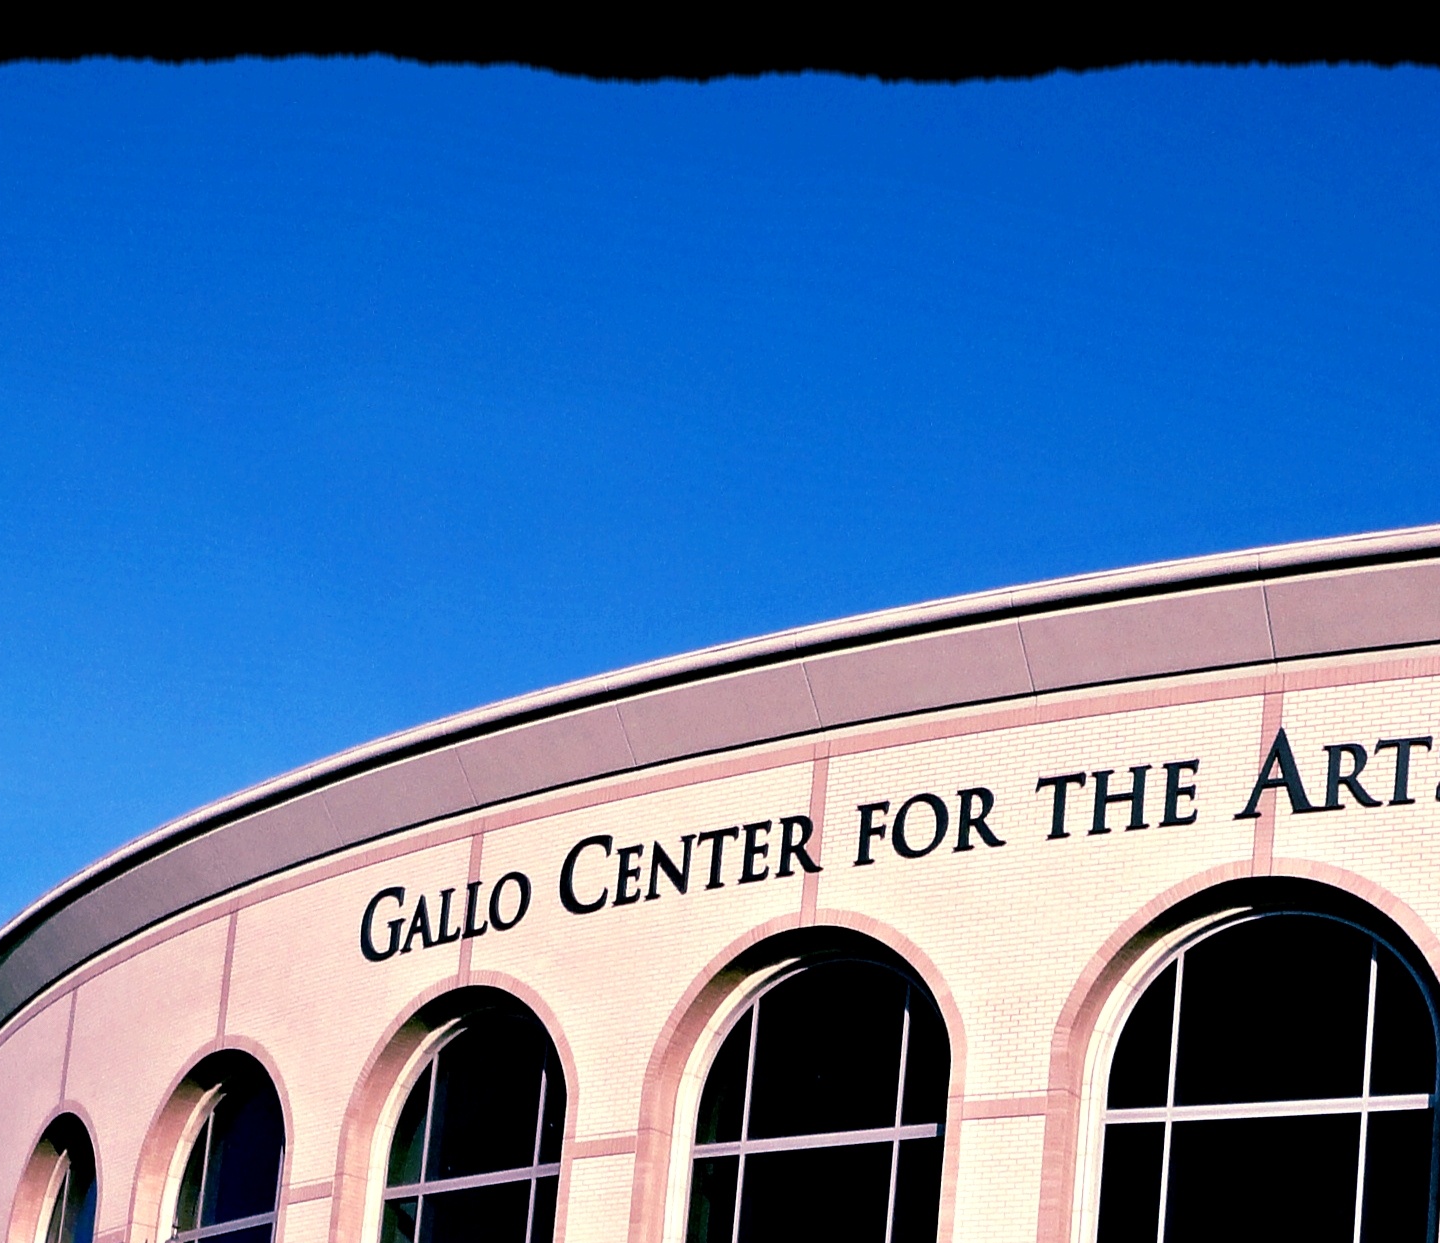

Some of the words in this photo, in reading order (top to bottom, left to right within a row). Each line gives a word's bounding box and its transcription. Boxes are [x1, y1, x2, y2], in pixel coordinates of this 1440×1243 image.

[359, 870, 532, 963] GALLO
[559, 813, 824, 916] CENTER
[852, 786, 1007, 868] FOR
[1035, 758, 1201, 841] THE
